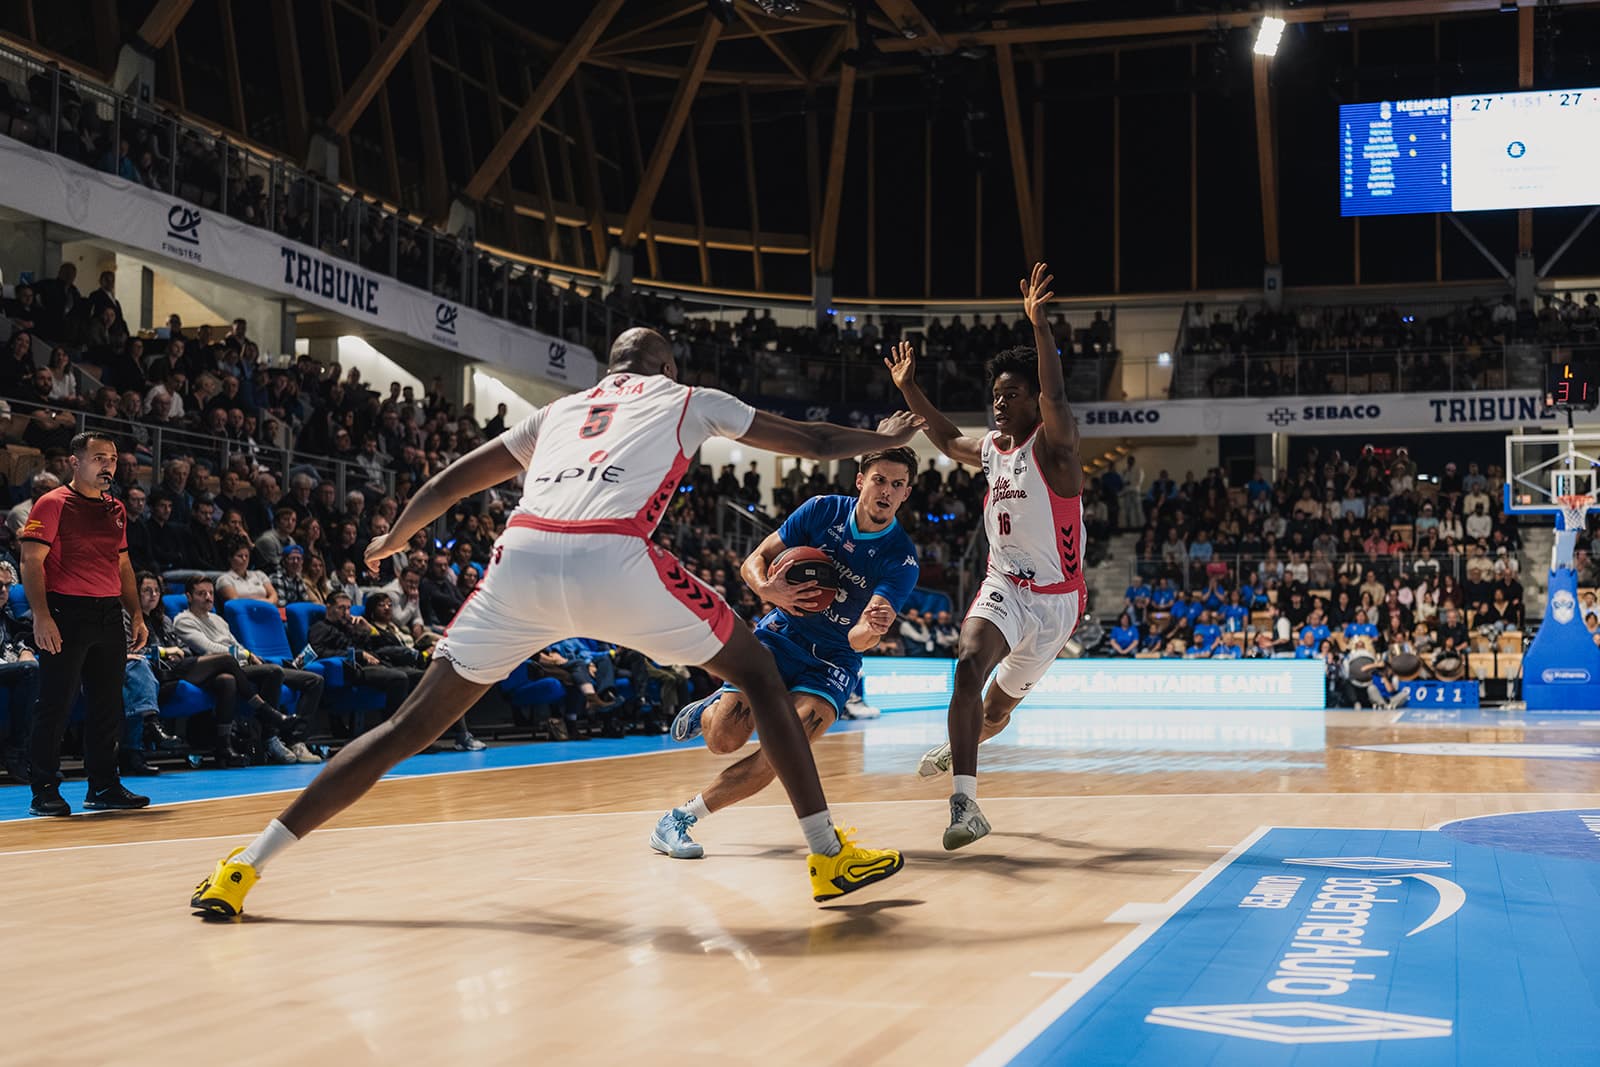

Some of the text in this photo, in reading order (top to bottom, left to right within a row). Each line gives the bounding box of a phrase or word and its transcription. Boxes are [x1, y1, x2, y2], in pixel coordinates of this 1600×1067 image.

[1396, 98, 1449, 112] KEMPER
[1471, 98, 1493, 111] 27
[1560, 92, 1582, 106] 27
[281, 246, 379, 315] TRIBUNE
[579, 403, 619, 440] 5
[1086, 409, 1160, 425] SEBACO
[1303, 404, 1381, 420] SEBACO
[998, 512, 1011, 536] 16
[1036, 671, 1292, 694] OMPLÉMENTAIRE SANTÉ
[1238, 875, 1306, 909] QUIMPER
[1266, 876, 1402, 996] BodemerAuto
